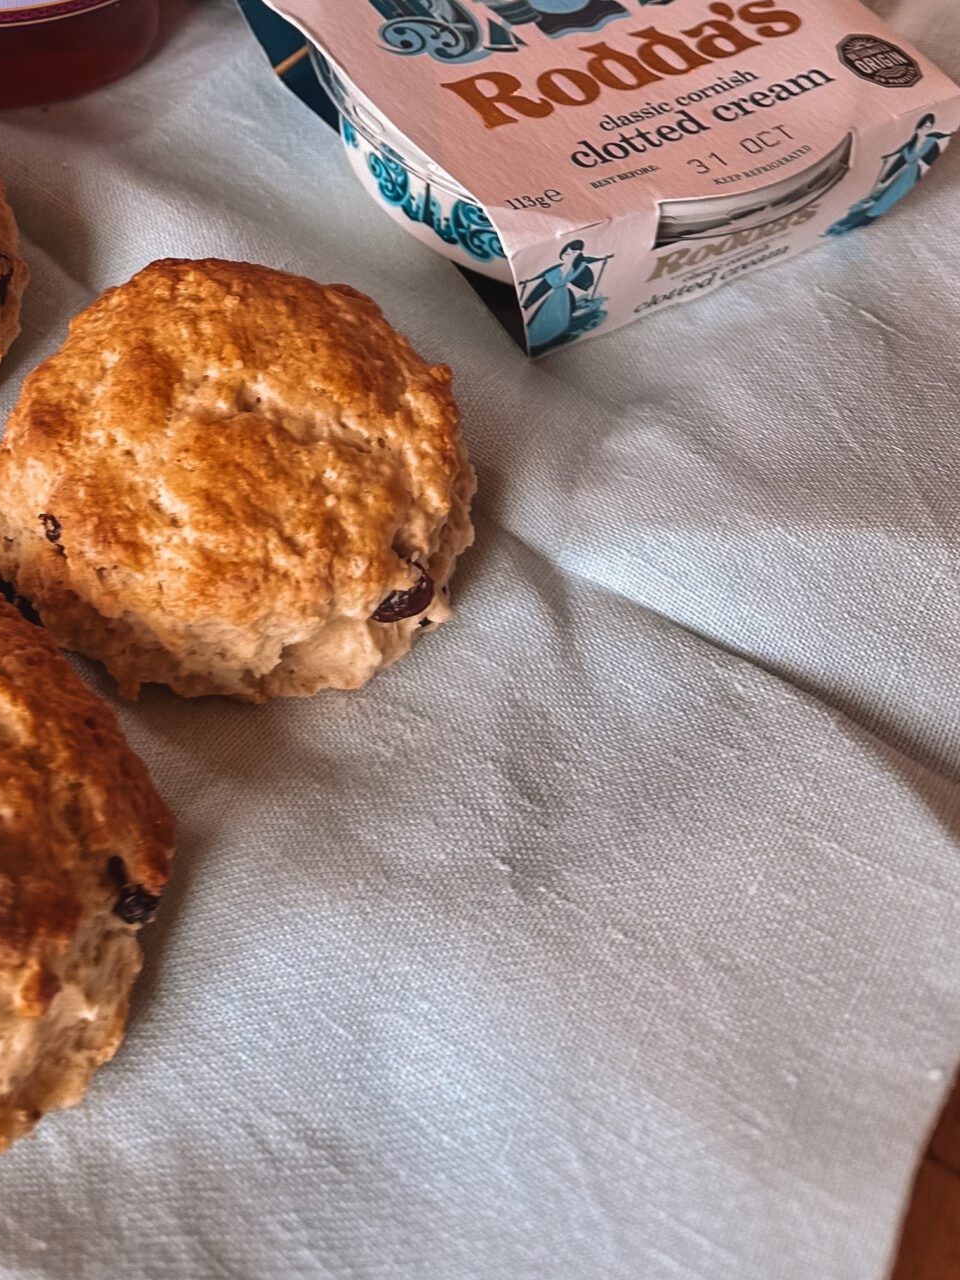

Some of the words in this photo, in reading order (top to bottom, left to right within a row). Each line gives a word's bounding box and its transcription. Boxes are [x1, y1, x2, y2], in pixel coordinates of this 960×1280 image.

[854, 51, 908, 74] ORIGIN
[570, 110, 711, 169] clotted
[712, 68, 836, 123] cream
[599, 101, 674, 132] classic
[675, 70, 760, 107] cornish
[686, 151, 729, 175] 31
[738, 124, 795, 155] OCT
[713, 170, 743, 187] KEEP
[742, 144, 813, 180] REFRIGERATED
[589, 172, 619, 190] BEST
